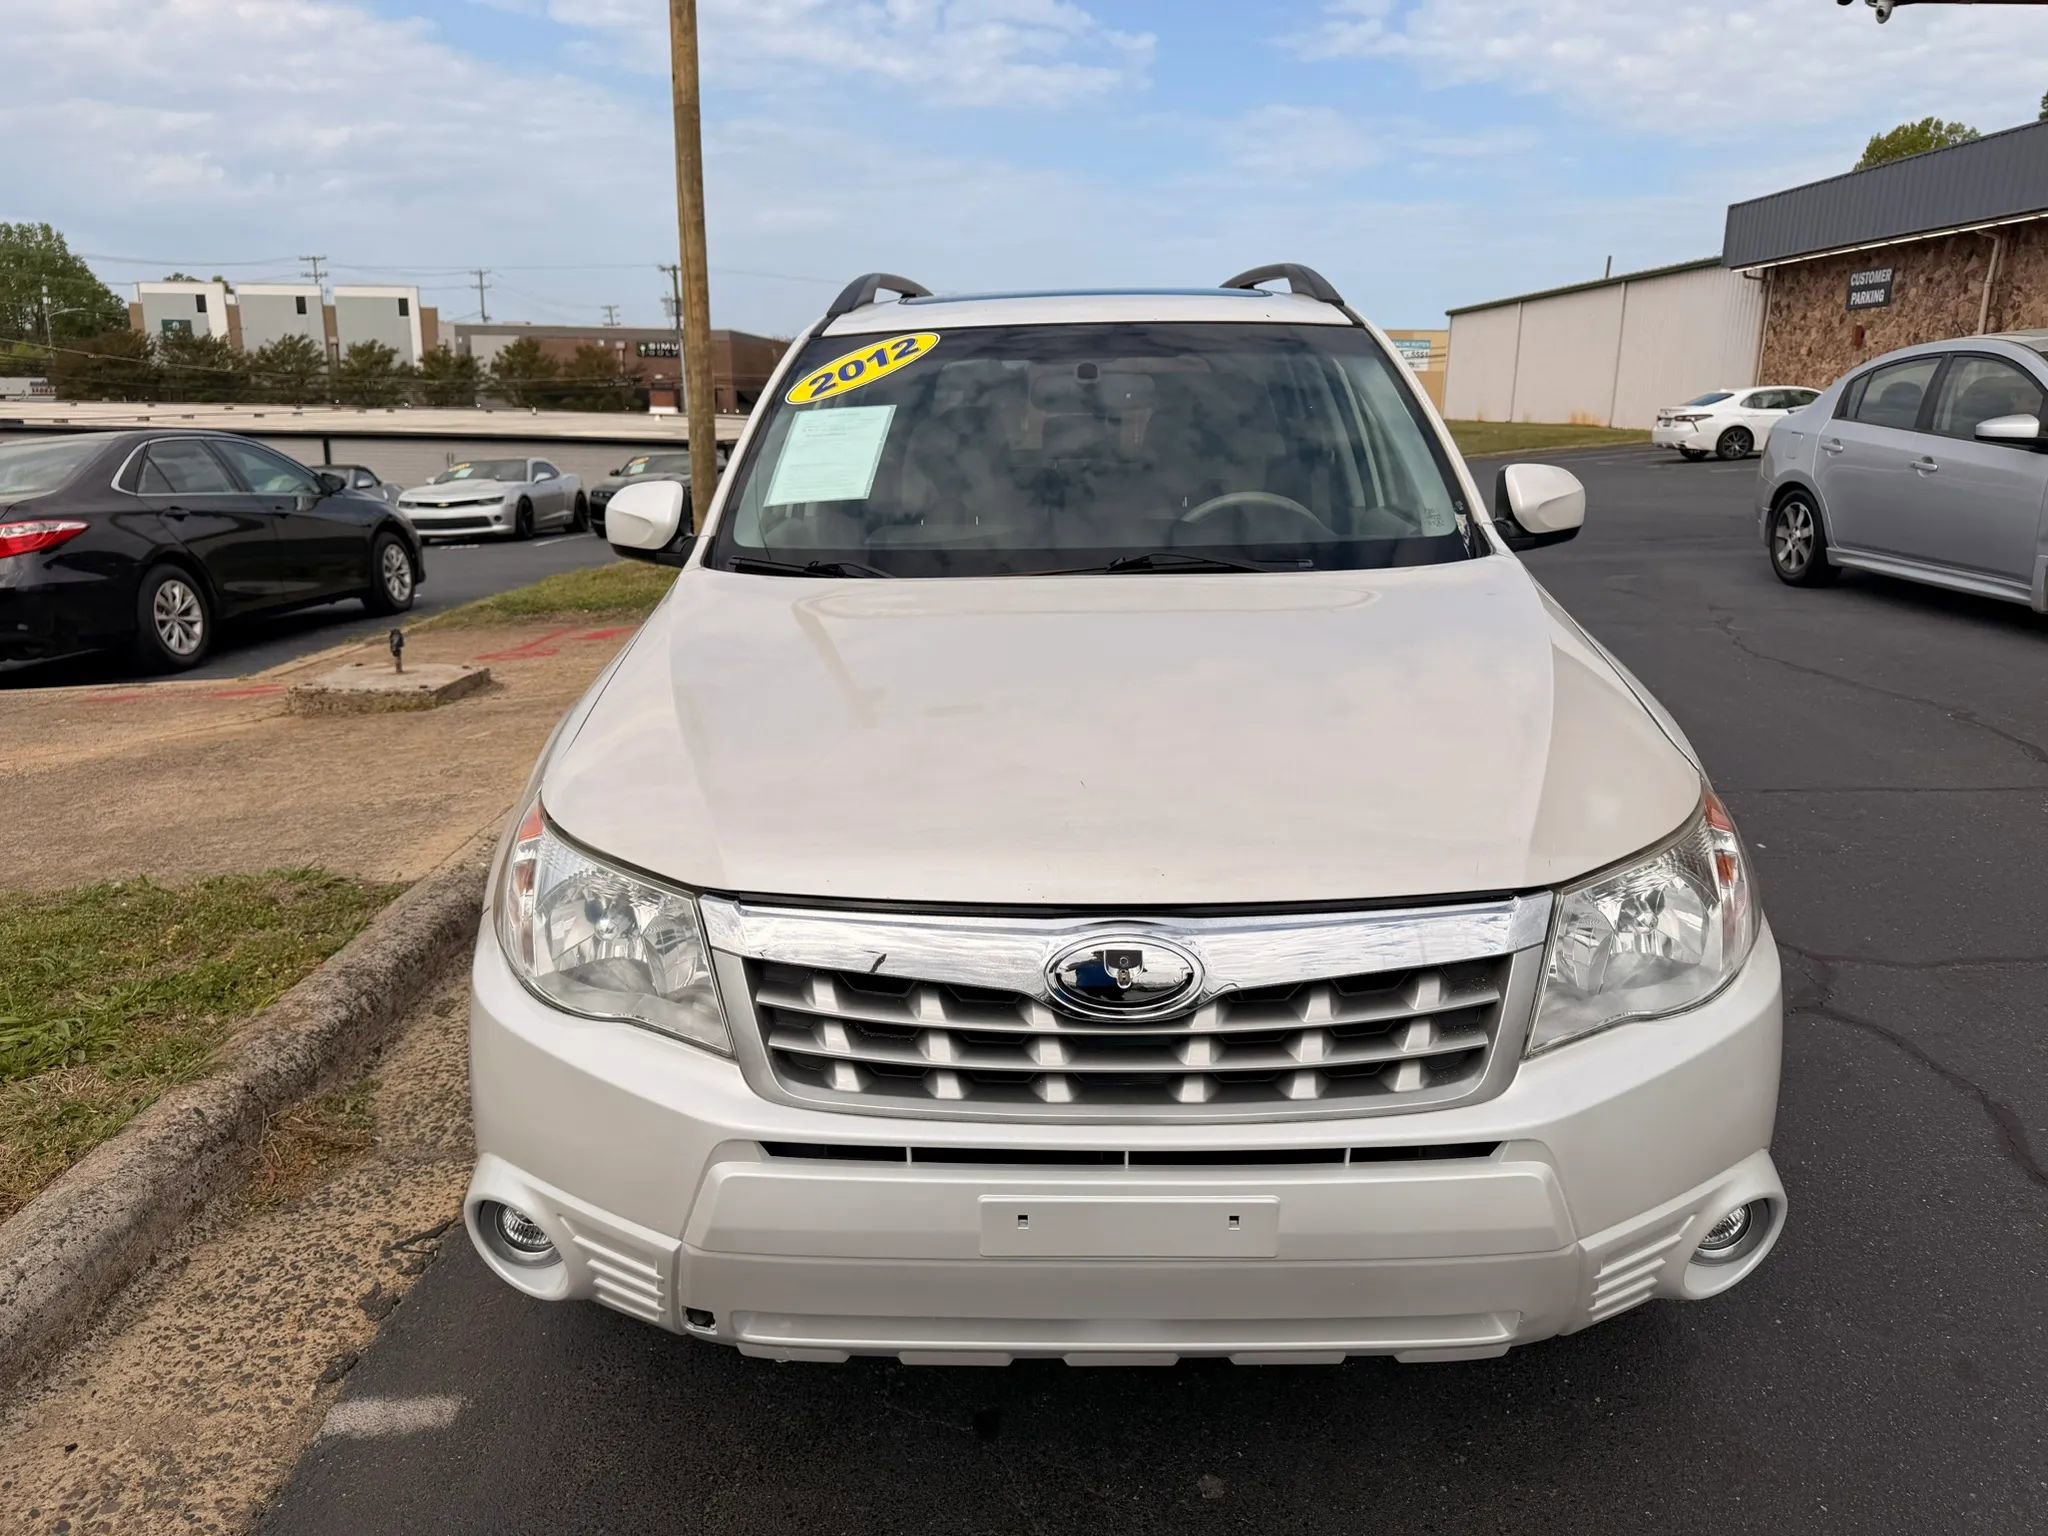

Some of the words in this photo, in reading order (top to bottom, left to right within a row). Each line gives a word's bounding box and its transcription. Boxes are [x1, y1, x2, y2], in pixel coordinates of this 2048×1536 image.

[1850, 269, 1892, 287] CUSTOMER
[1850, 289, 1885, 305] PARKING
[808, 338, 921, 398] 2012
